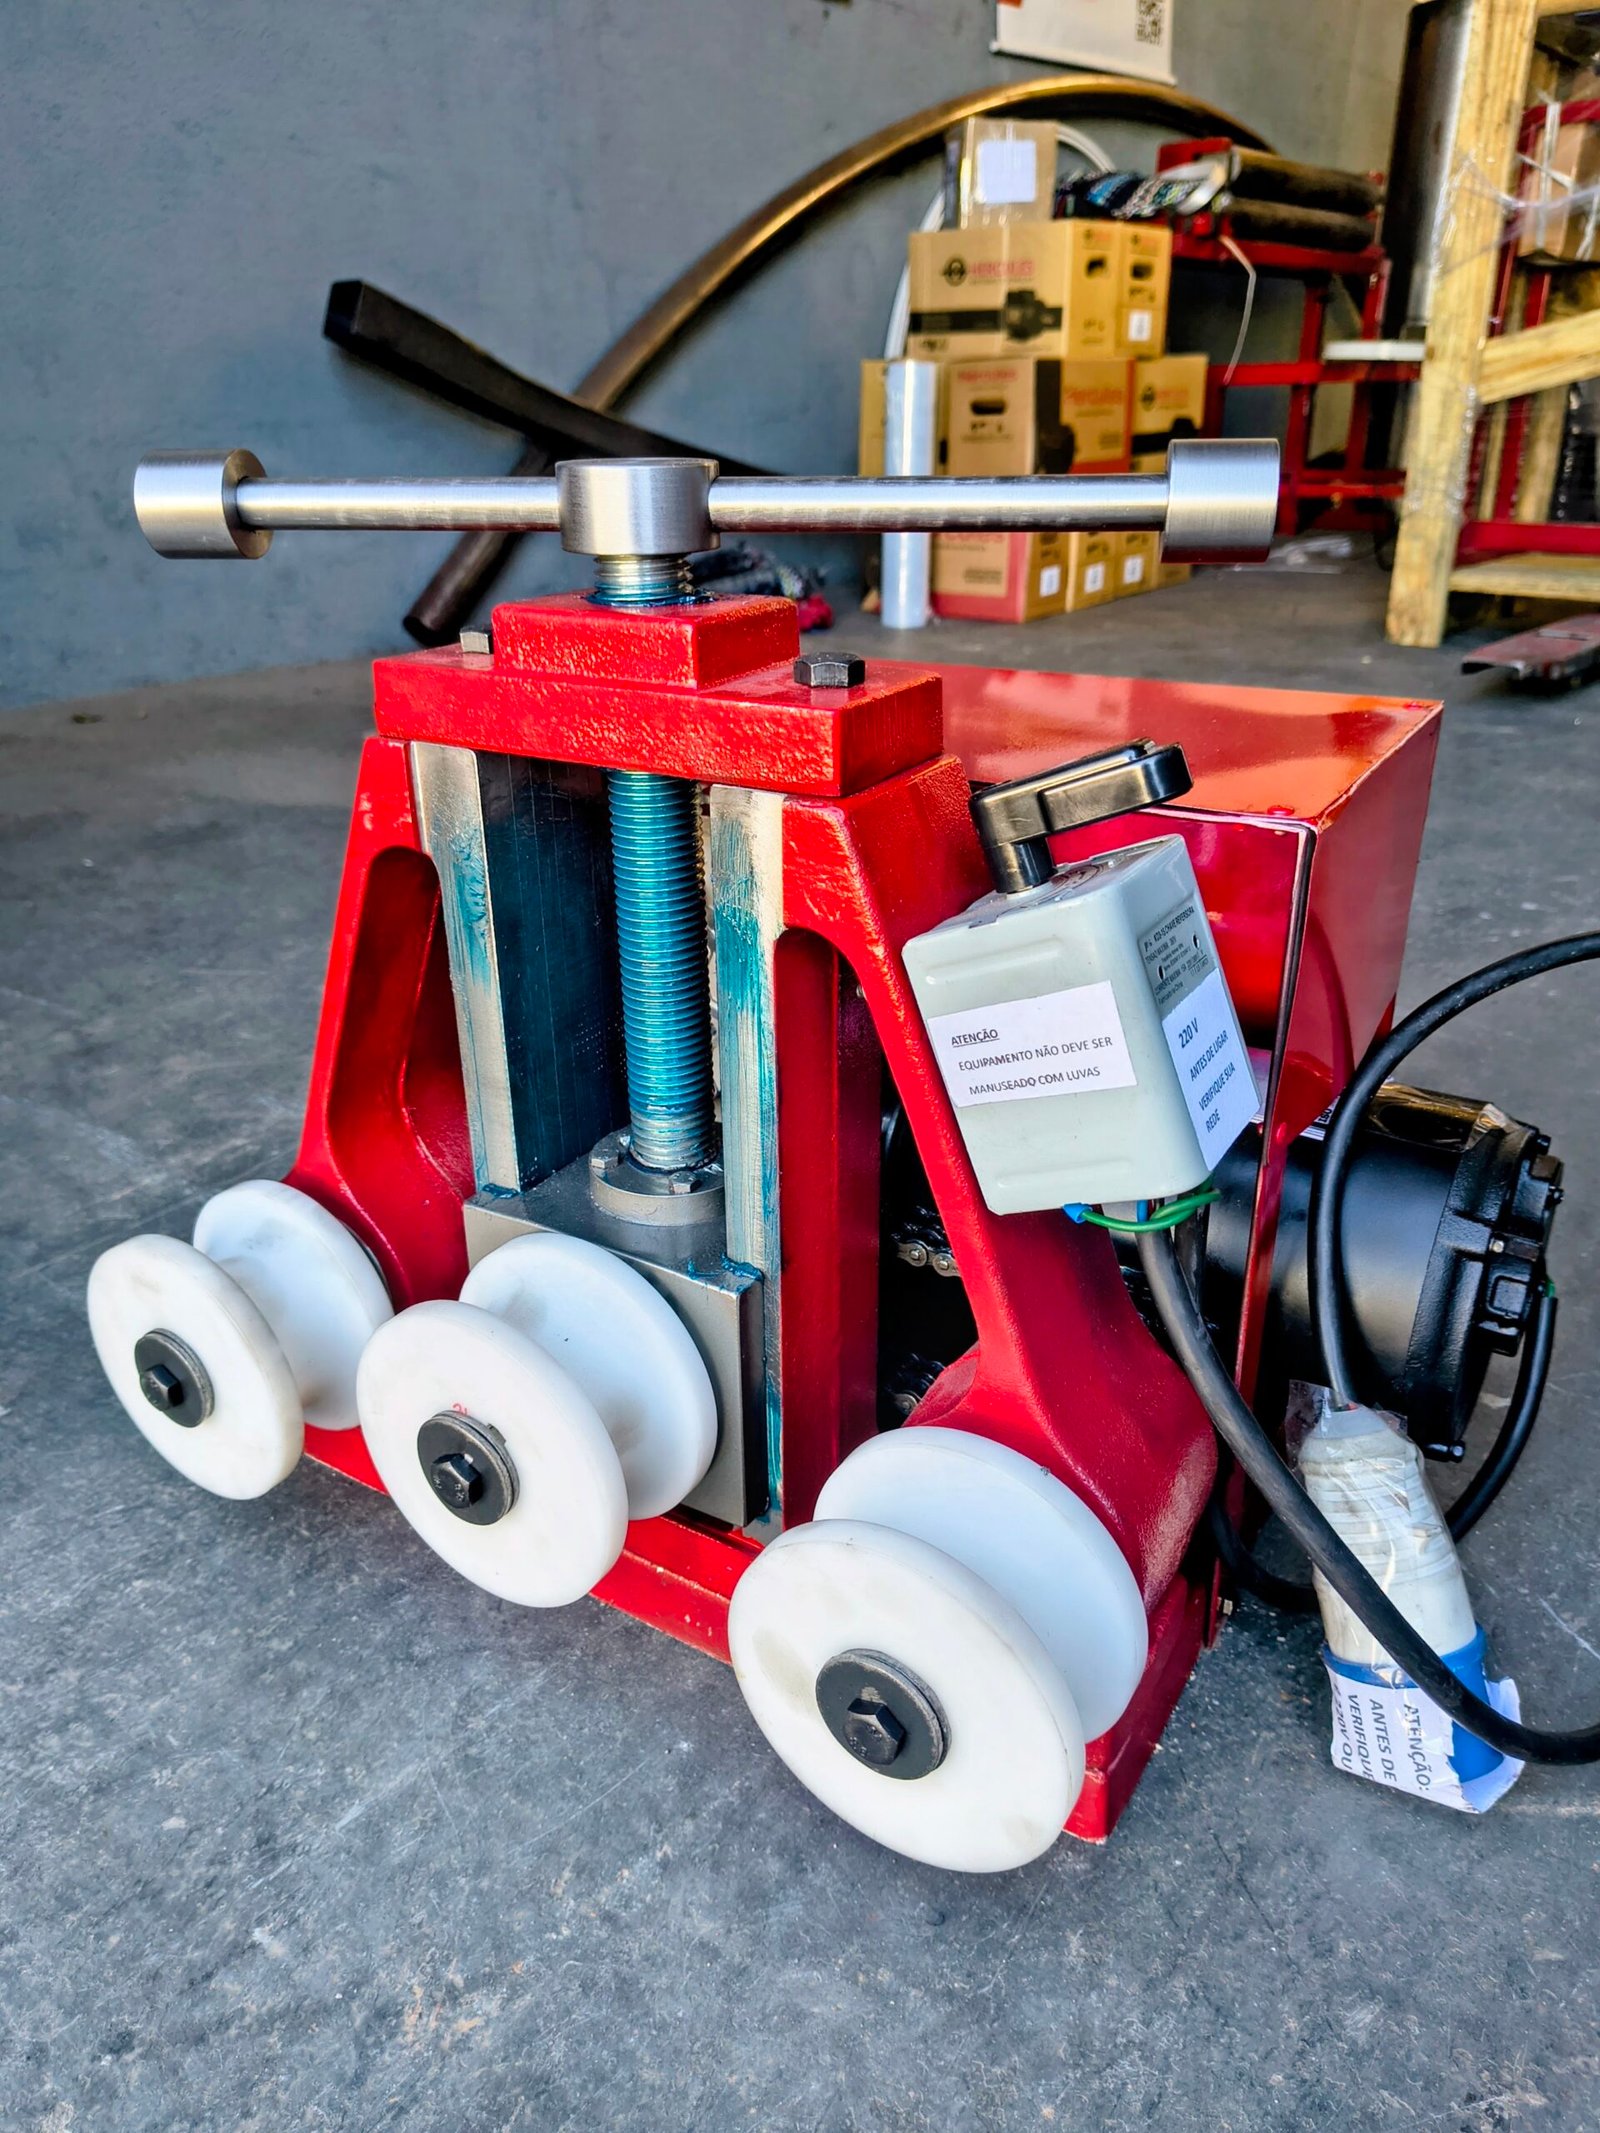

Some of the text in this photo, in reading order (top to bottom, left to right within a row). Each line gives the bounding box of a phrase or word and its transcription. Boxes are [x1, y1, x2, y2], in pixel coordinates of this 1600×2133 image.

[951, 1029, 998, 1046] ATENÇÃO
[1178, 1017, 1198, 1049] 220 V
[959, 1036, 1112, 1071] EQUIPAMENTO NÃO DEVE SER
[1189, 1030, 1228, 1082] ANTES DE LIGAR
[969, 1066, 1100, 1095] MANUSEADO COM LUVAS
[1198, 1062, 1235, 1111] VERIFIQUE SUA
[1205, 1108, 1221, 1133] REDE
[1341, 1742, 1353, 1770] OU
[1369, 1698, 1398, 1783] ANTES DE
